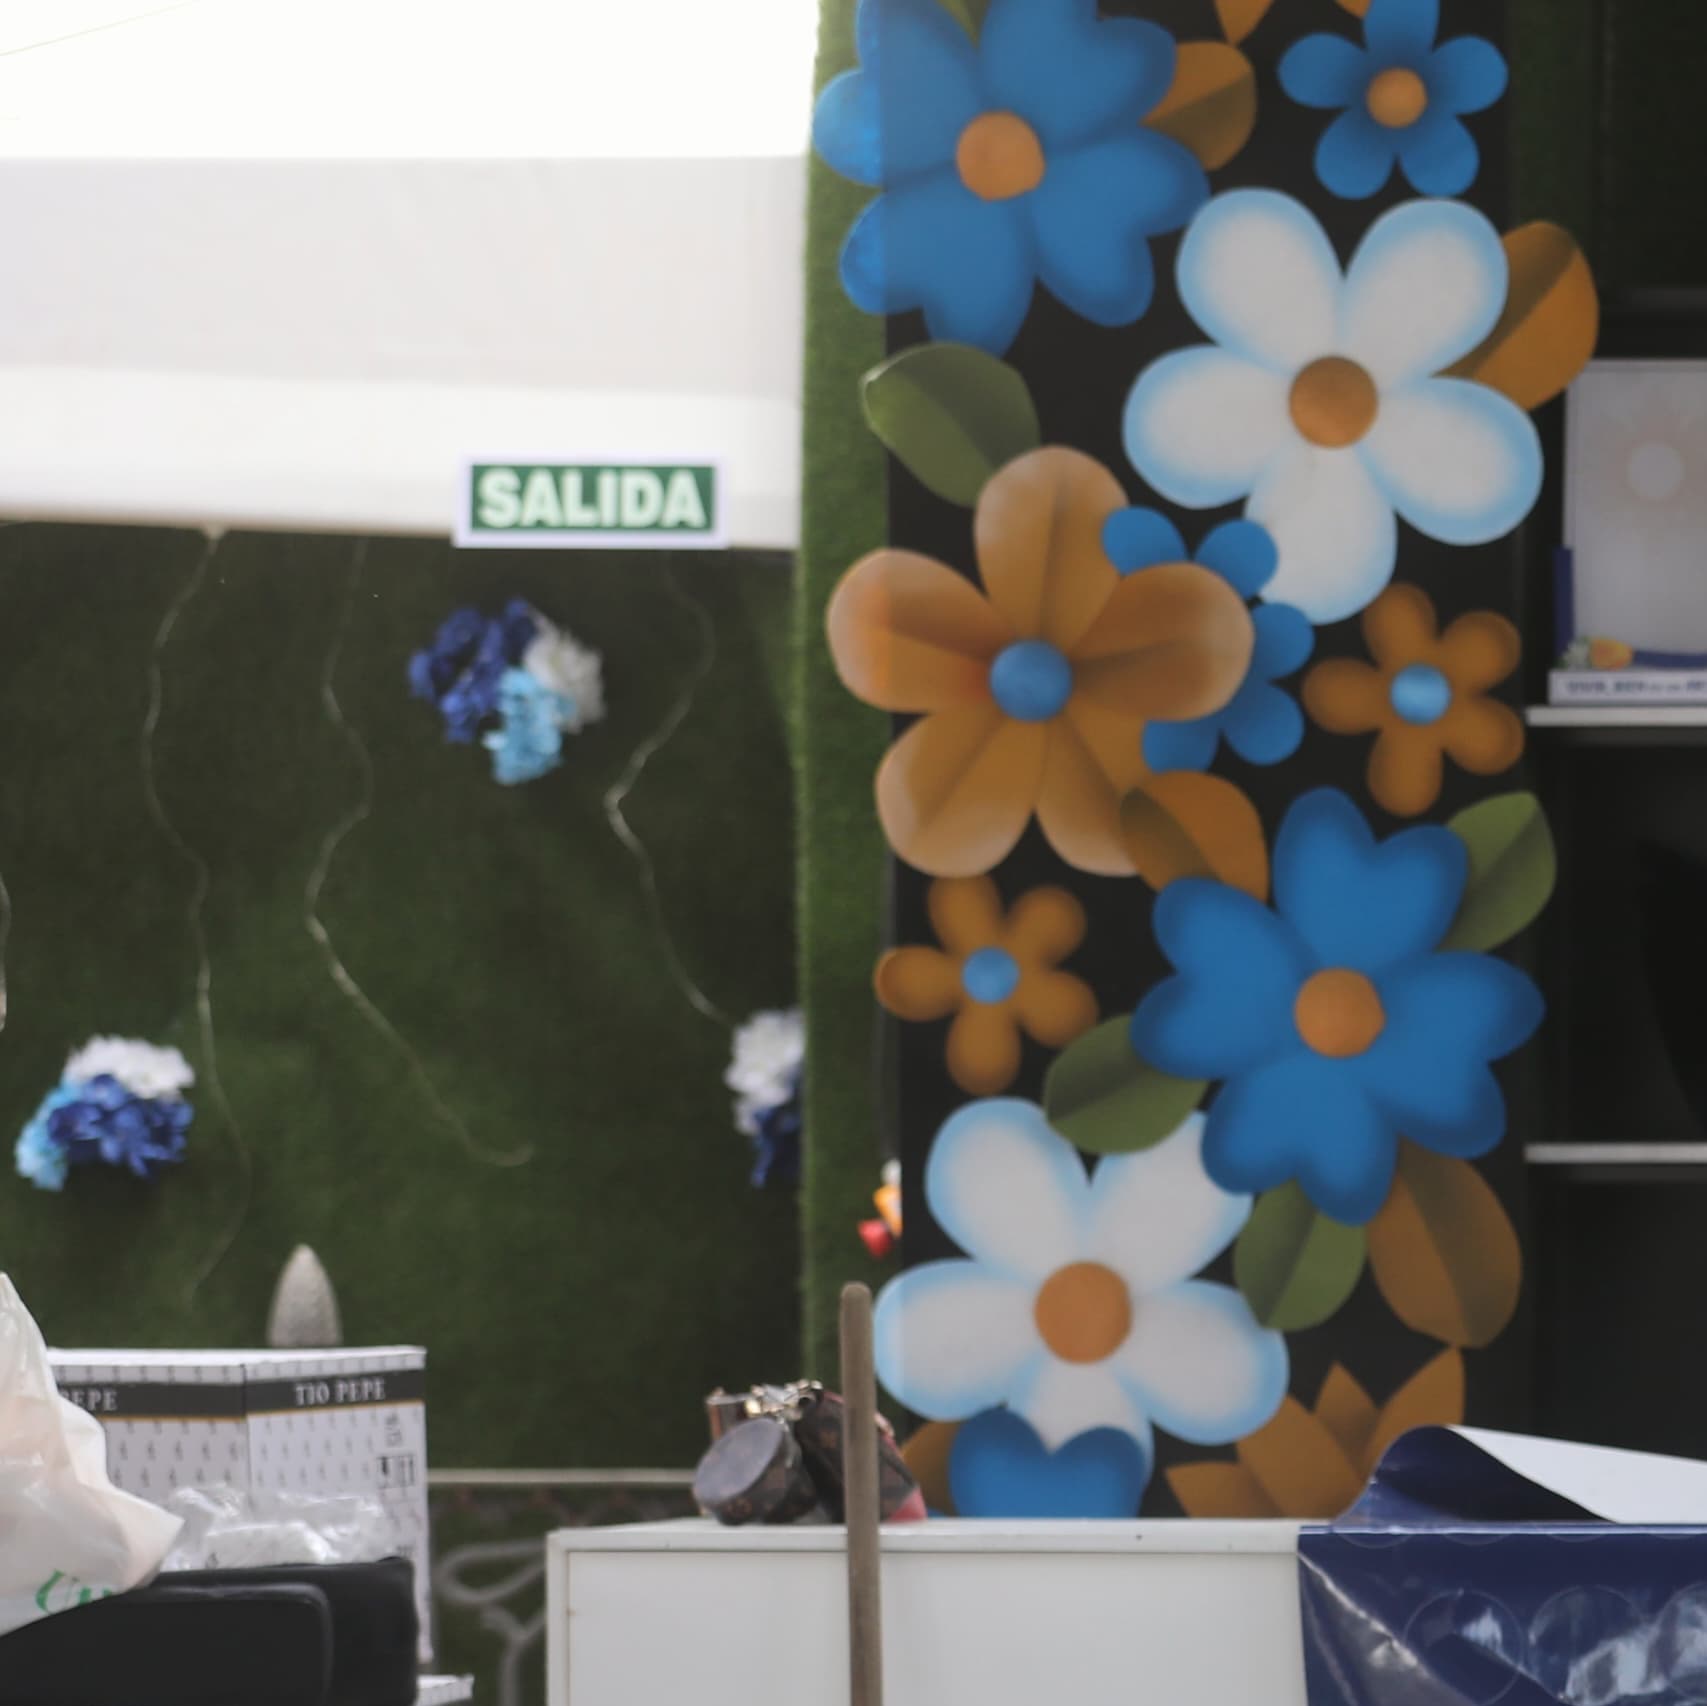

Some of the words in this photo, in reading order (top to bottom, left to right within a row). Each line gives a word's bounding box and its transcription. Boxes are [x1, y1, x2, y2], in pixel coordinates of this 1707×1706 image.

[477, 466, 708, 528] SALIDA
[295, 1384, 329, 1406] TIO
[335, 1377, 386, 1402] PEPE
